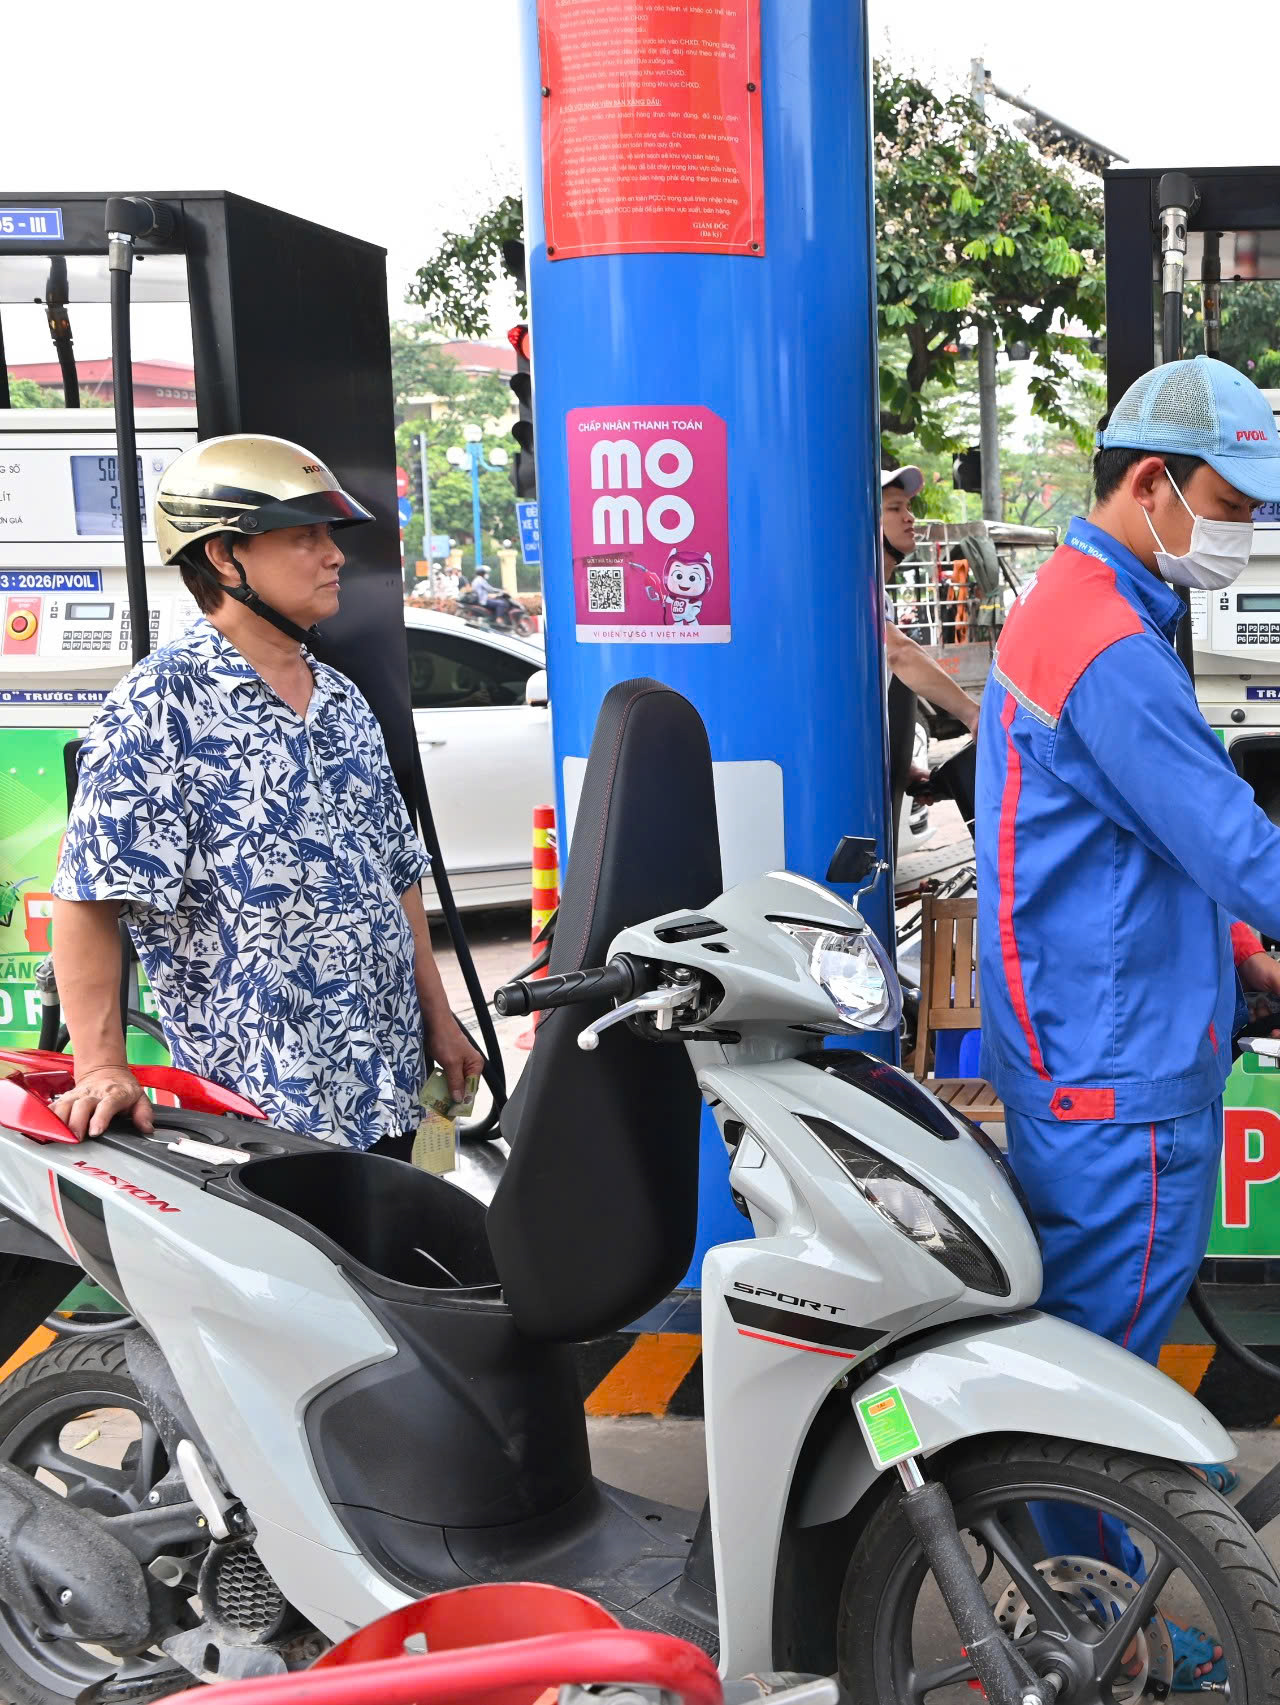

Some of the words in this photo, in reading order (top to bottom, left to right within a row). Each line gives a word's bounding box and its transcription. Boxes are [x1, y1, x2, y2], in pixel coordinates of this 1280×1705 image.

[578, 420, 601, 432] CHẤP
[602, 419, 631, 431] NHẬN
[632, 421, 670, 430] THANH
[672, 419, 703, 430] TOÁN
[1236, 429, 1268, 441] PVOIL
[9, 464, 21, 474] SỐ
[18, 575, 94, 589] 2026/PVOIL
[657, 630, 676, 639] VIỆT
[24, 691, 74, 701] TRƯỚC
[77, 692, 104, 701] KHI
[73, 1160, 182, 1213] VISION
[733, 1281, 846, 1315] SPORT
